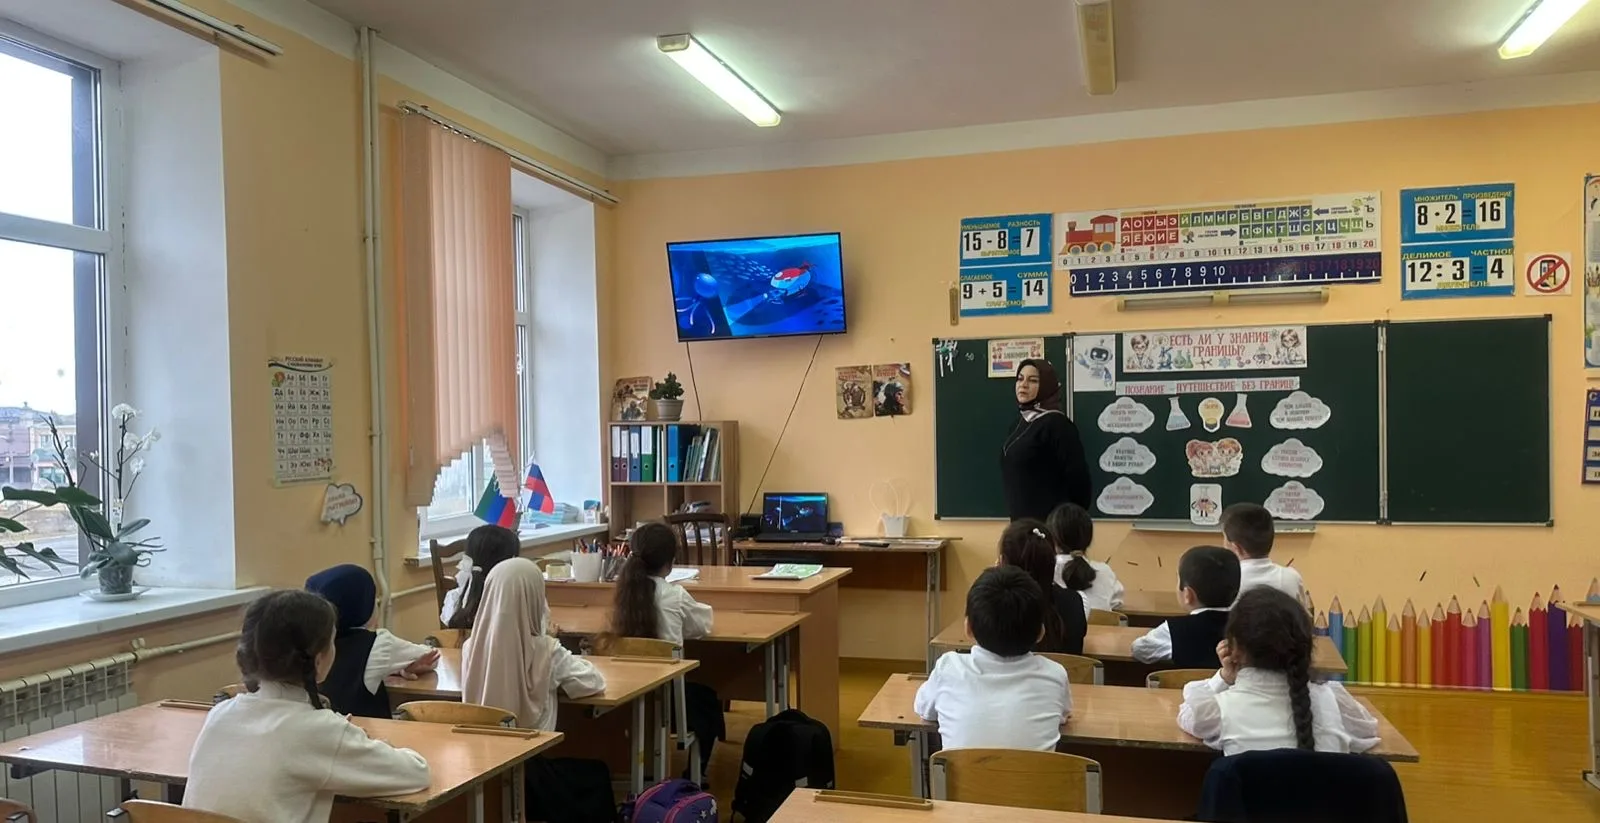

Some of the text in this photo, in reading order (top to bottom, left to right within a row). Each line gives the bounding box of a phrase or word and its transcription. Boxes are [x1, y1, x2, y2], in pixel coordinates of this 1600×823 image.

[1418, 205, 1428, 225] 8
[1445, 203, 1456, 224] 2
[1480, 201, 1500, 222] 16
[964, 232, 981, 251] 15
[998, 231, 1006, 249] 8
[1026, 229, 1034, 248] 7
[1402, 251, 1452, 260] ДЕЛИМОЕ
[1070, 274, 1077, 284] 0
[1085, 274, 1089, 283] 1
[1099, 272, 1104, 282] 2
[1112, 271, 1118, 282] 3
[1126, 271, 1132, 280] 4
[1141, 270, 1147, 280] 5
[1155, 269, 1162, 279] 6
[1170, 268, 1176, 278] 7
[1185, 267, 1191, 277] 8
[1200, 266, 1206, 276] 9
[1213, 266, 1225, 276] 10
[1408, 262, 1432, 282] 12
[1452, 260, 1464, 280] 3
[1490, 258, 1504, 279] 4
[963, 284, 973, 299] 9
[993, 282, 1002, 298] 5
[1024, 280, 1044, 296] 14
[1170, 332, 1269, 346] ЕСТЬ ЛИ У ЗНАНИЯ
[1192, 345, 1245, 358] ГРАНИЦЫ?
[1176, 381, 1235, 393] ПУТЕШЕСТВИЕ
[1242, 381, 1255, 390] БЕЗ
